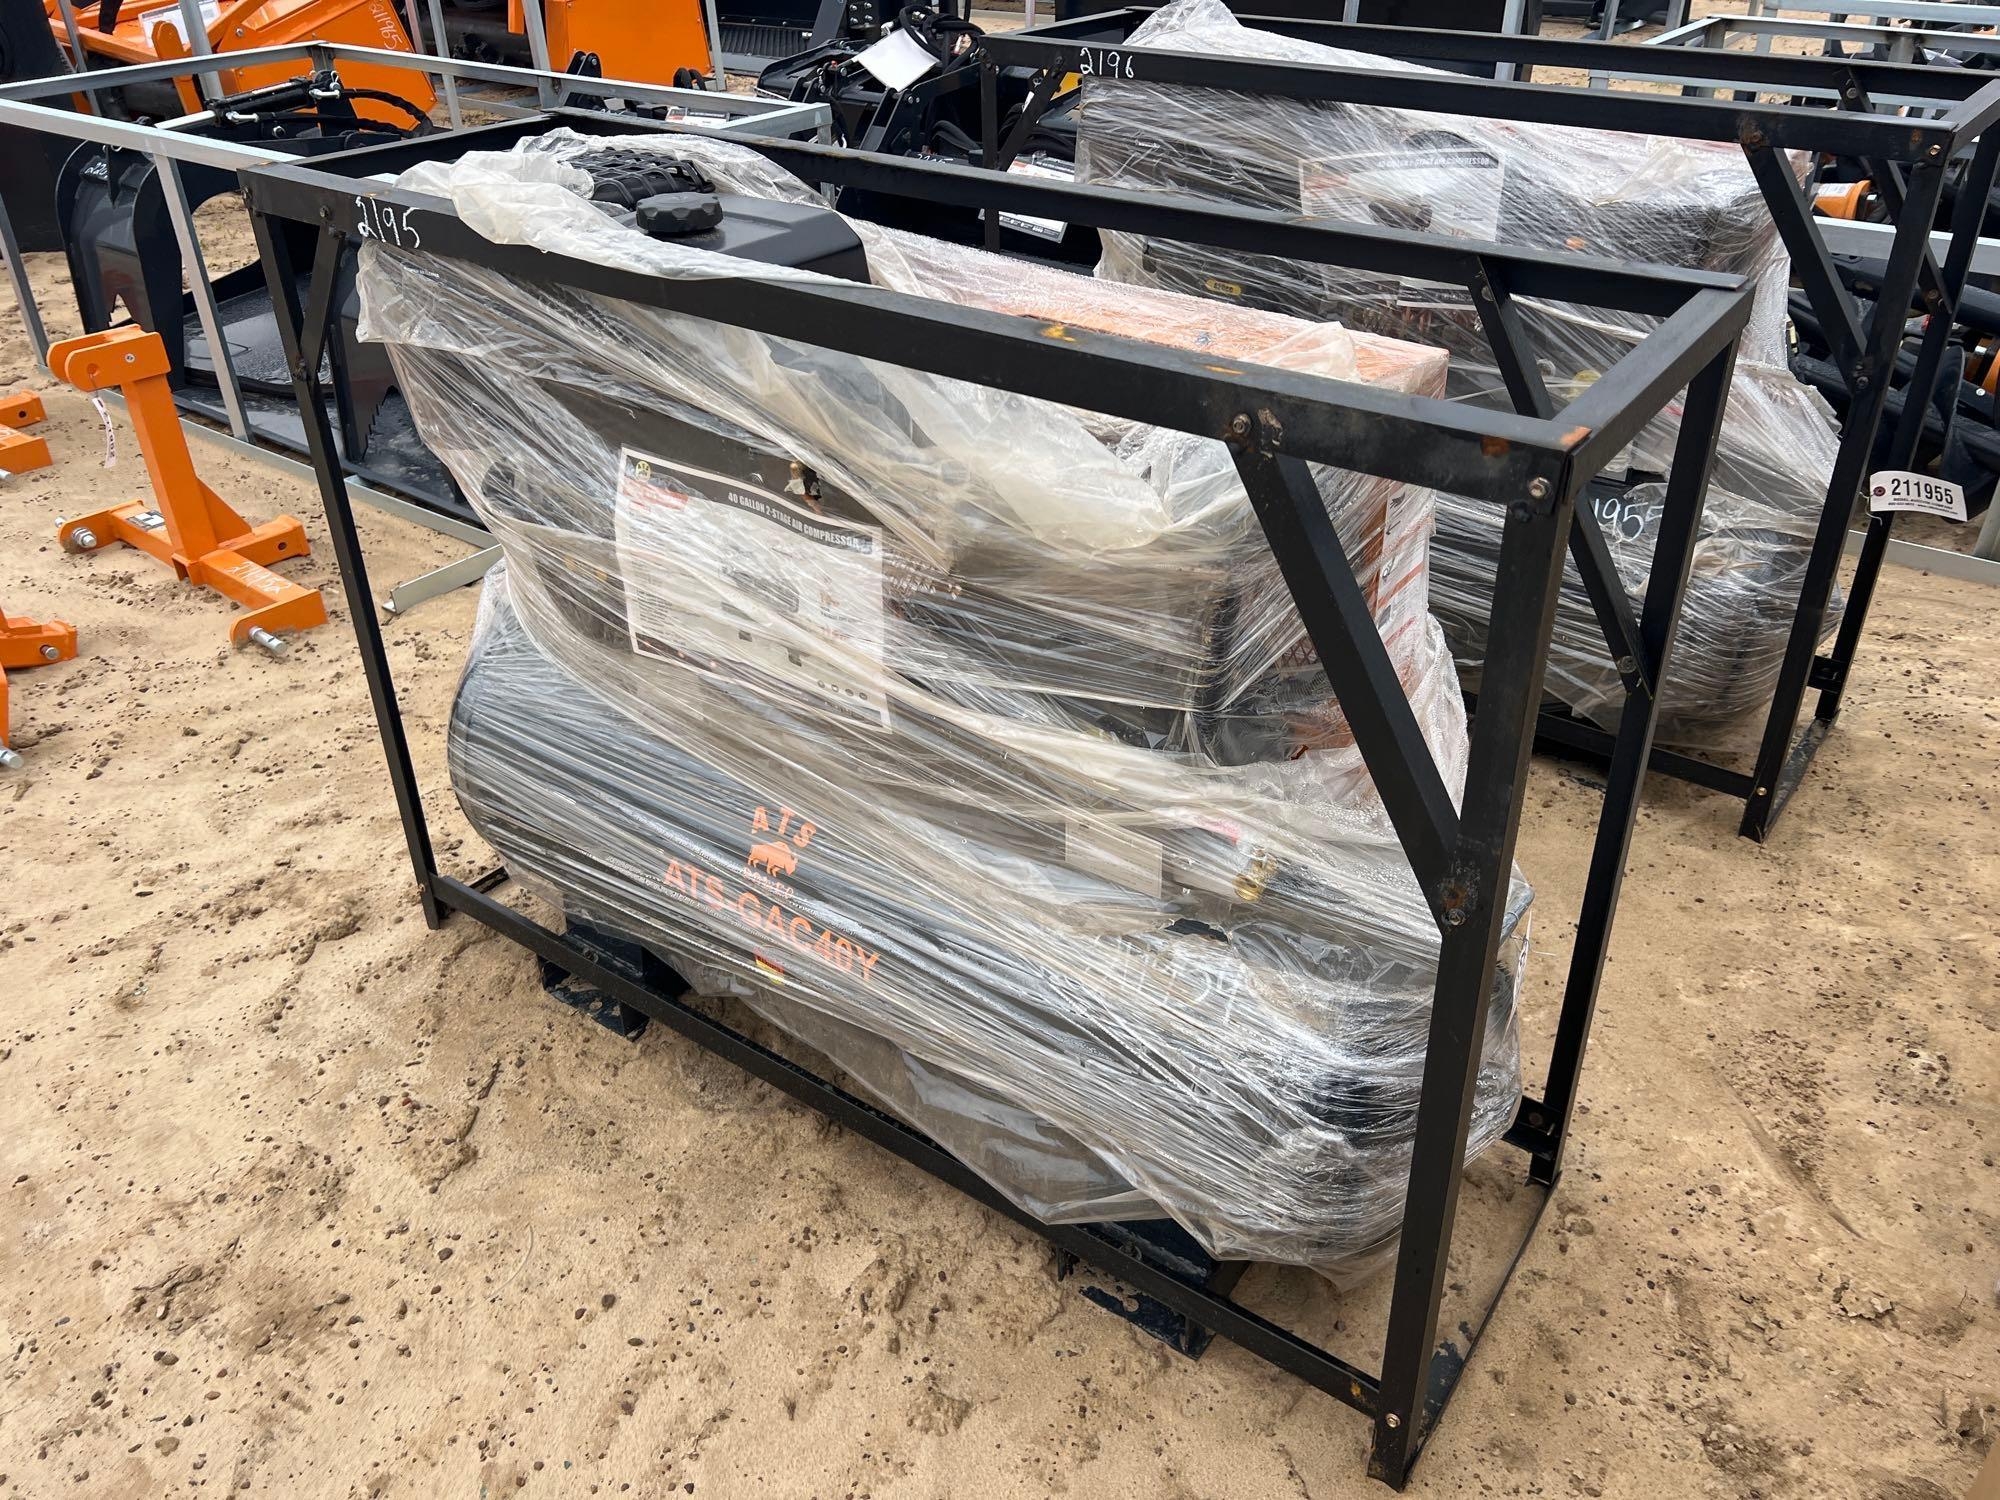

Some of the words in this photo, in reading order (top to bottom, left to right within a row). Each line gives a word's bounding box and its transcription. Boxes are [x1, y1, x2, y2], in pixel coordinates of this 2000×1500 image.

[1079, 47, 1135, 79] 2196
[355, 196, 421, 249] 2195
[1891, 478, 1953, 504] 211955
[728, 492, 739, 504] 40
[739, 495, 766, 514] GALLON
[765, 505, 792, 527] 2-STAGE
[791, 518, 804, 532] AIR
[803, 525, 860, 549] COMPRESSOR
[751, 805, 817, 848] ATS
